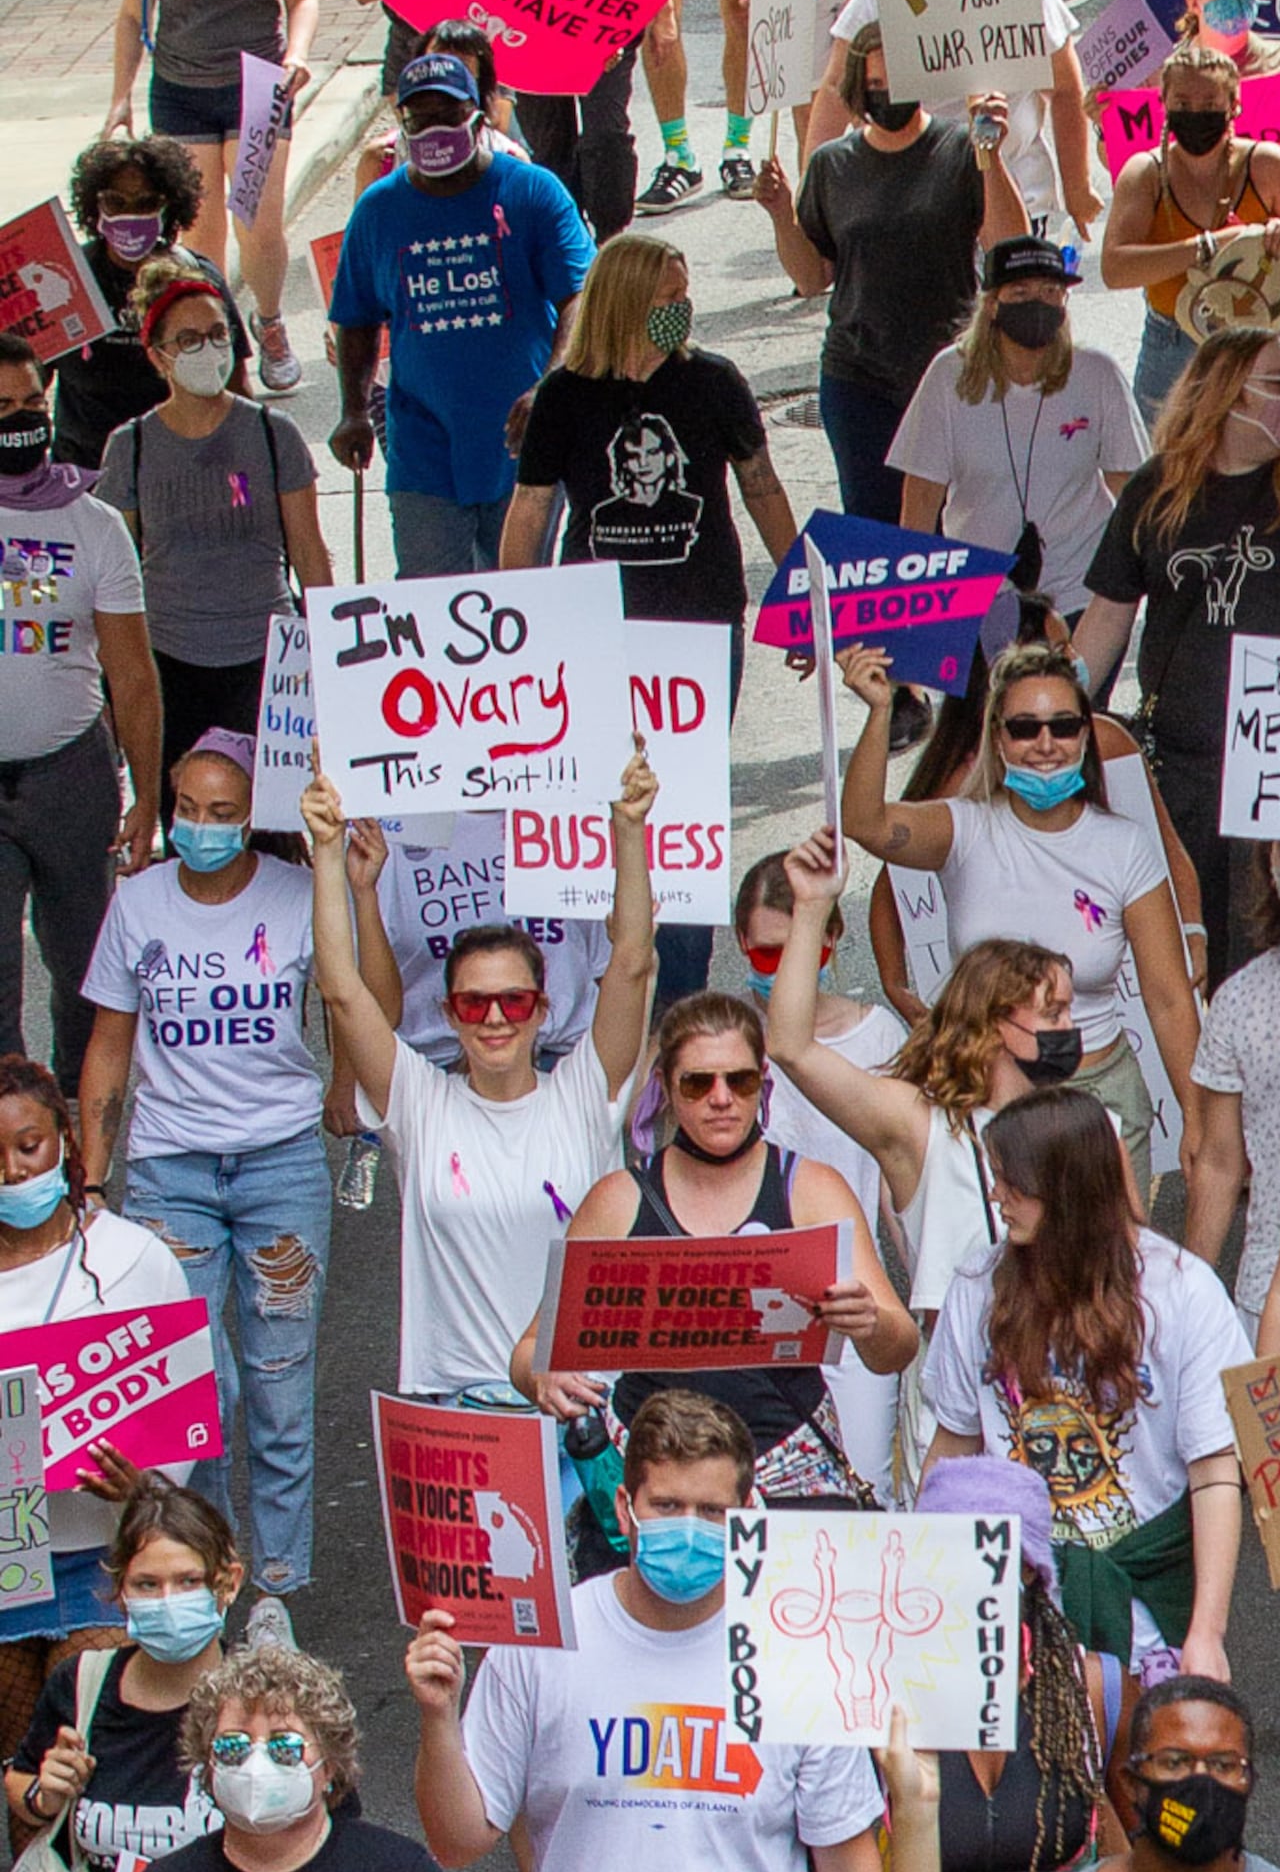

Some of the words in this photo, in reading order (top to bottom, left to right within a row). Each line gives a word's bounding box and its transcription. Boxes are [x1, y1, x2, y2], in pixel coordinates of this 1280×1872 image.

[594, 29, 632, 47] TO
[918, 29, 973, 72] WAR
[980, 23, 1046, 62] PAINT
[407, 273, 440, 298] He
[447, 265, 500, 292] Lost
[331, 596, 424, 667] I'm
[444, 590, 528, 665] So
[381, 661, 570, 761] Ovary
[350, 753, 442, 795] This
[588, 1717, 740, 1784] YDATL
[585, 1799, 620, 1808] YOUNG
[621, 1798, 678, 1809] DEMOCRATS
[694, 1803, 739, 1813] ATLANTA
